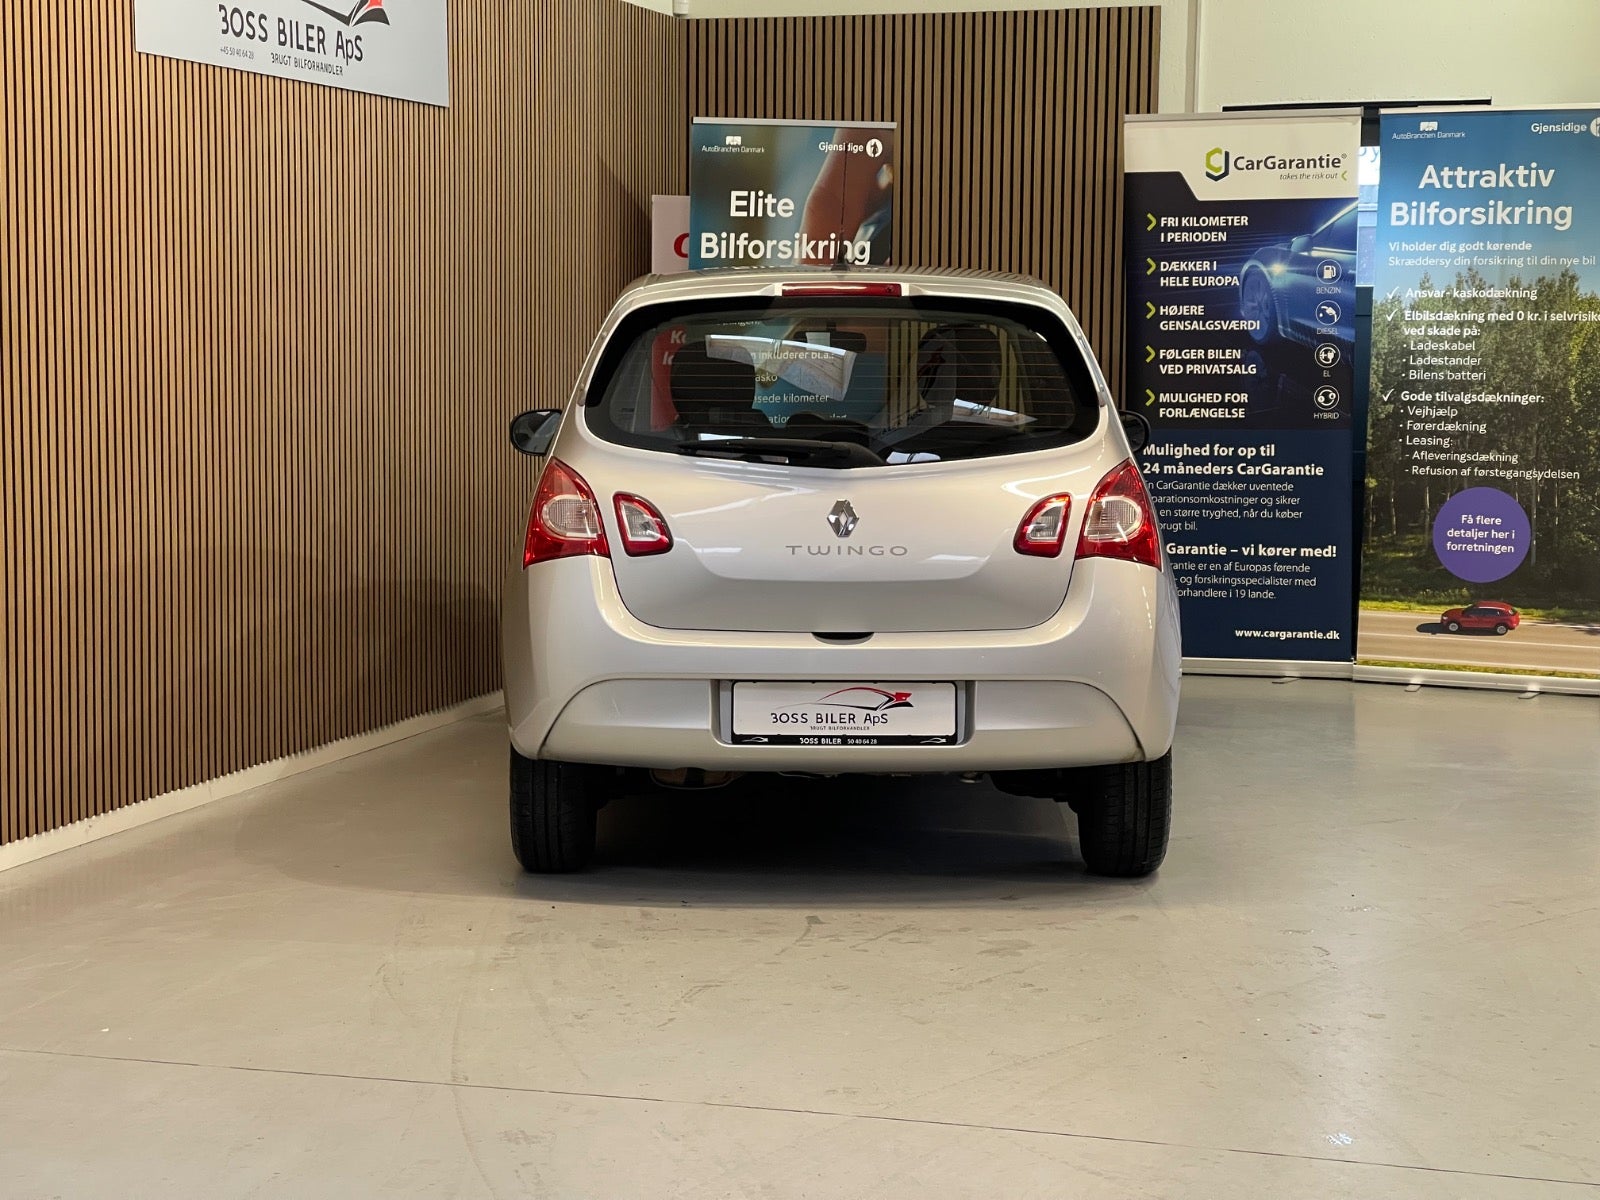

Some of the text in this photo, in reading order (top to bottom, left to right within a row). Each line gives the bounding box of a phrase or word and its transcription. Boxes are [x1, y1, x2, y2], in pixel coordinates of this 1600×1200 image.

[278, 17, 326, 55] BILER
[335, 30, 363, 66] ApS
[294, 57, 344, 76] BILFORHANDLER
[1531, 122, 1588, 135] Gjensidige
[1392, 131, 1466, 140] AutoBranchen Danmark
[702, 145, 765, 154] AutoBranchen Danmark
[1300, 172, 1311, 180] the
[1312, 172, 1325, 180] risk
[1326, 172, 1338, 180] out
[1418, 162, 1555, 189] Attraktiv
[730, 190, 795, 218] Elite
[1390, 199, 1573, 231] Bilforsikring
[1160, 216, 1249, 227] FRI KILOMETER
[1160, 232, 1227, 243] I PERIODEN
[1389, 241, 1532, 253] Vi holder dig godt kørende
[1160, 261, 1217, 272] DÆKKER I
[1388, 255, 1596, 267] Skræddersy din forsikring til din nye bil
[1160, 276, 1240, 287] HELE EUROPA
[1406, 287, 1538, 300] Ansvar- kaskodækning
[1160, 305, 1205, 316] HØJERE
[1404, 310, 1485, 323] Elbilsdækning
[1487, 311, 1514, 321] med
[1517, 311, 1525, 321] 0
[1527, 311, 1541, 321] kr.
[1544, 311, 1548, 321] i
[1160, 320, 1260, 331] GENSALGSVÆRDI
[1316, 327, 1340, 335] DIESEL
[1404, 325, 1481, 338] ved skade på:
[1410, 340, 1476, 351] Ladeskabel
[1160, 349, 1241, 360] FØLGER BILEN
[1409, 355, 1482, 366] Ladestander
[1160, 364, 1257, 375] VED PRIVATSALG
[1323, 370, 1331, 378] EL
[1409, 370, 1486, 380] Bilens batteri
[783, 393, 829, 403] kilometer
[1159, 392, 1249, 403] MULIGHED FOR
[1401, 391, 1545, 405] Gode tilvalgsdækninger:
[1159, 407, 1246, 418] FORLÆNGELSE
[1313, 412, 1340, 420] HYBRID
[1407, 406, 1458, 418] Vejhjælp
[1406, 421, 1487, 434] Førerdækning
[1406, 436, 1453, 448] Leasing:
[1143, 444, 1275, 459] Mulighed for op til
[1412, 451, 1518, 464] Afleveringsdækning
[1143, 462, 1325, 476] 24 måneders CarGarantie
[1411, 466, 1580, 480] Refusion af førstegangsydelsen
[1156, 481, 1211, 491] CarGarantie
[1212, 481, 1246, 491] dækker
[1249, 482, 1294, 491] uventede
[1260, 497, 1273, 506] og
[1275, 495, 1301, 505] sikrer
[1173, 509, 1200, 517] større
[1202, 508, 1241, 519] tryghed,
[1243, 508, 1257, 518] når
[1260, 509, 1273, 518] du
[1275, 509, 1303, 519] køber
[1461, 514, 1502, 525] Få flere
[1184, 521, 1198, 531] bil.
[1447, 528, 1515, 539] detaljer her i
[785, 545, 908, 556] TWINGO
[1242, 545, 1255, 556] vi
[1258, 545, 1296, 557] kører
[1300, 545, 1337, 557] med!
[1446, 542, 1515, 554] forretningen
[1198, 563, 1208, 571] er
[1210, 563, 1222, 571] en
[1223, 562, 1233, 571] af
[1234, 562, 1271, 573] Europas
[1273, 563, 1311, 572] førende
[1180, 577, 1192, 586] og
[1194, 575, 1293, 587] forsikringsspecialister
[1294, 577, 1317, 586] med
[1235, 590, 1246, 598] 19
[1248, 590, 1277, 599] lande.
[1235, 629, 1340, 640] www.cargarantie.dk
[815, 713, 856, 724] BILER
[864, 713, 888, 726] ApS
[821, 737, 842, 745] BILER
